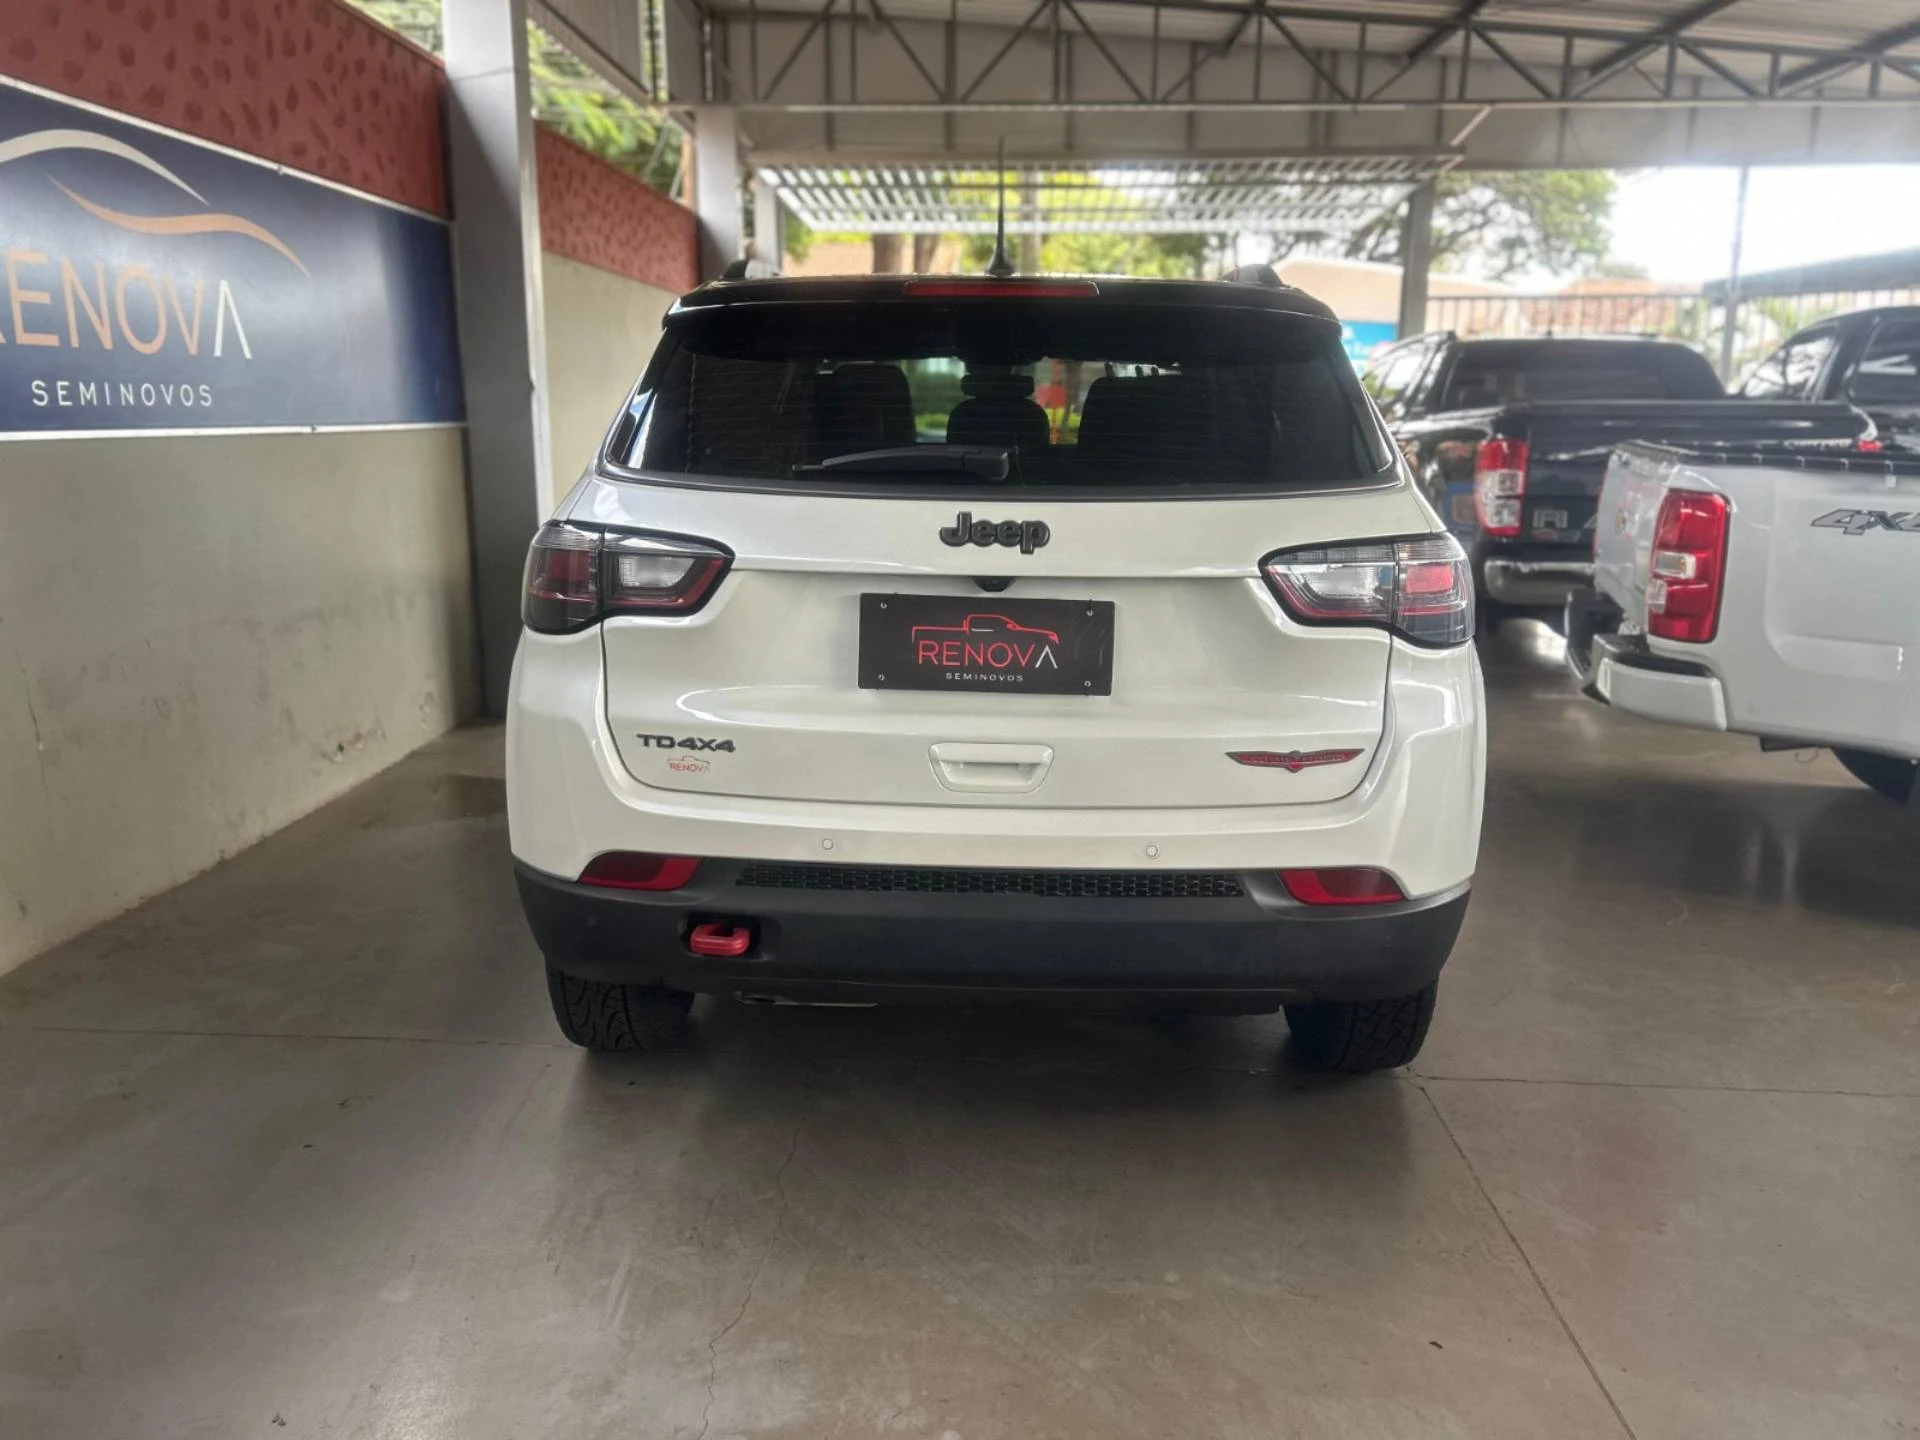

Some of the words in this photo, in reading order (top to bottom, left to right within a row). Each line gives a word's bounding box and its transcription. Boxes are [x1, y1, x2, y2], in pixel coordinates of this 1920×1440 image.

[0, 249, 252, 360] ENOVA
[31, 379, 213, 407] SEMINOVOS
[940, 511, 1050, 555] Jeep
[918, 640, 1058, 669] RENOVA
[946, 672, 1024, 682] SEMINOVOS
